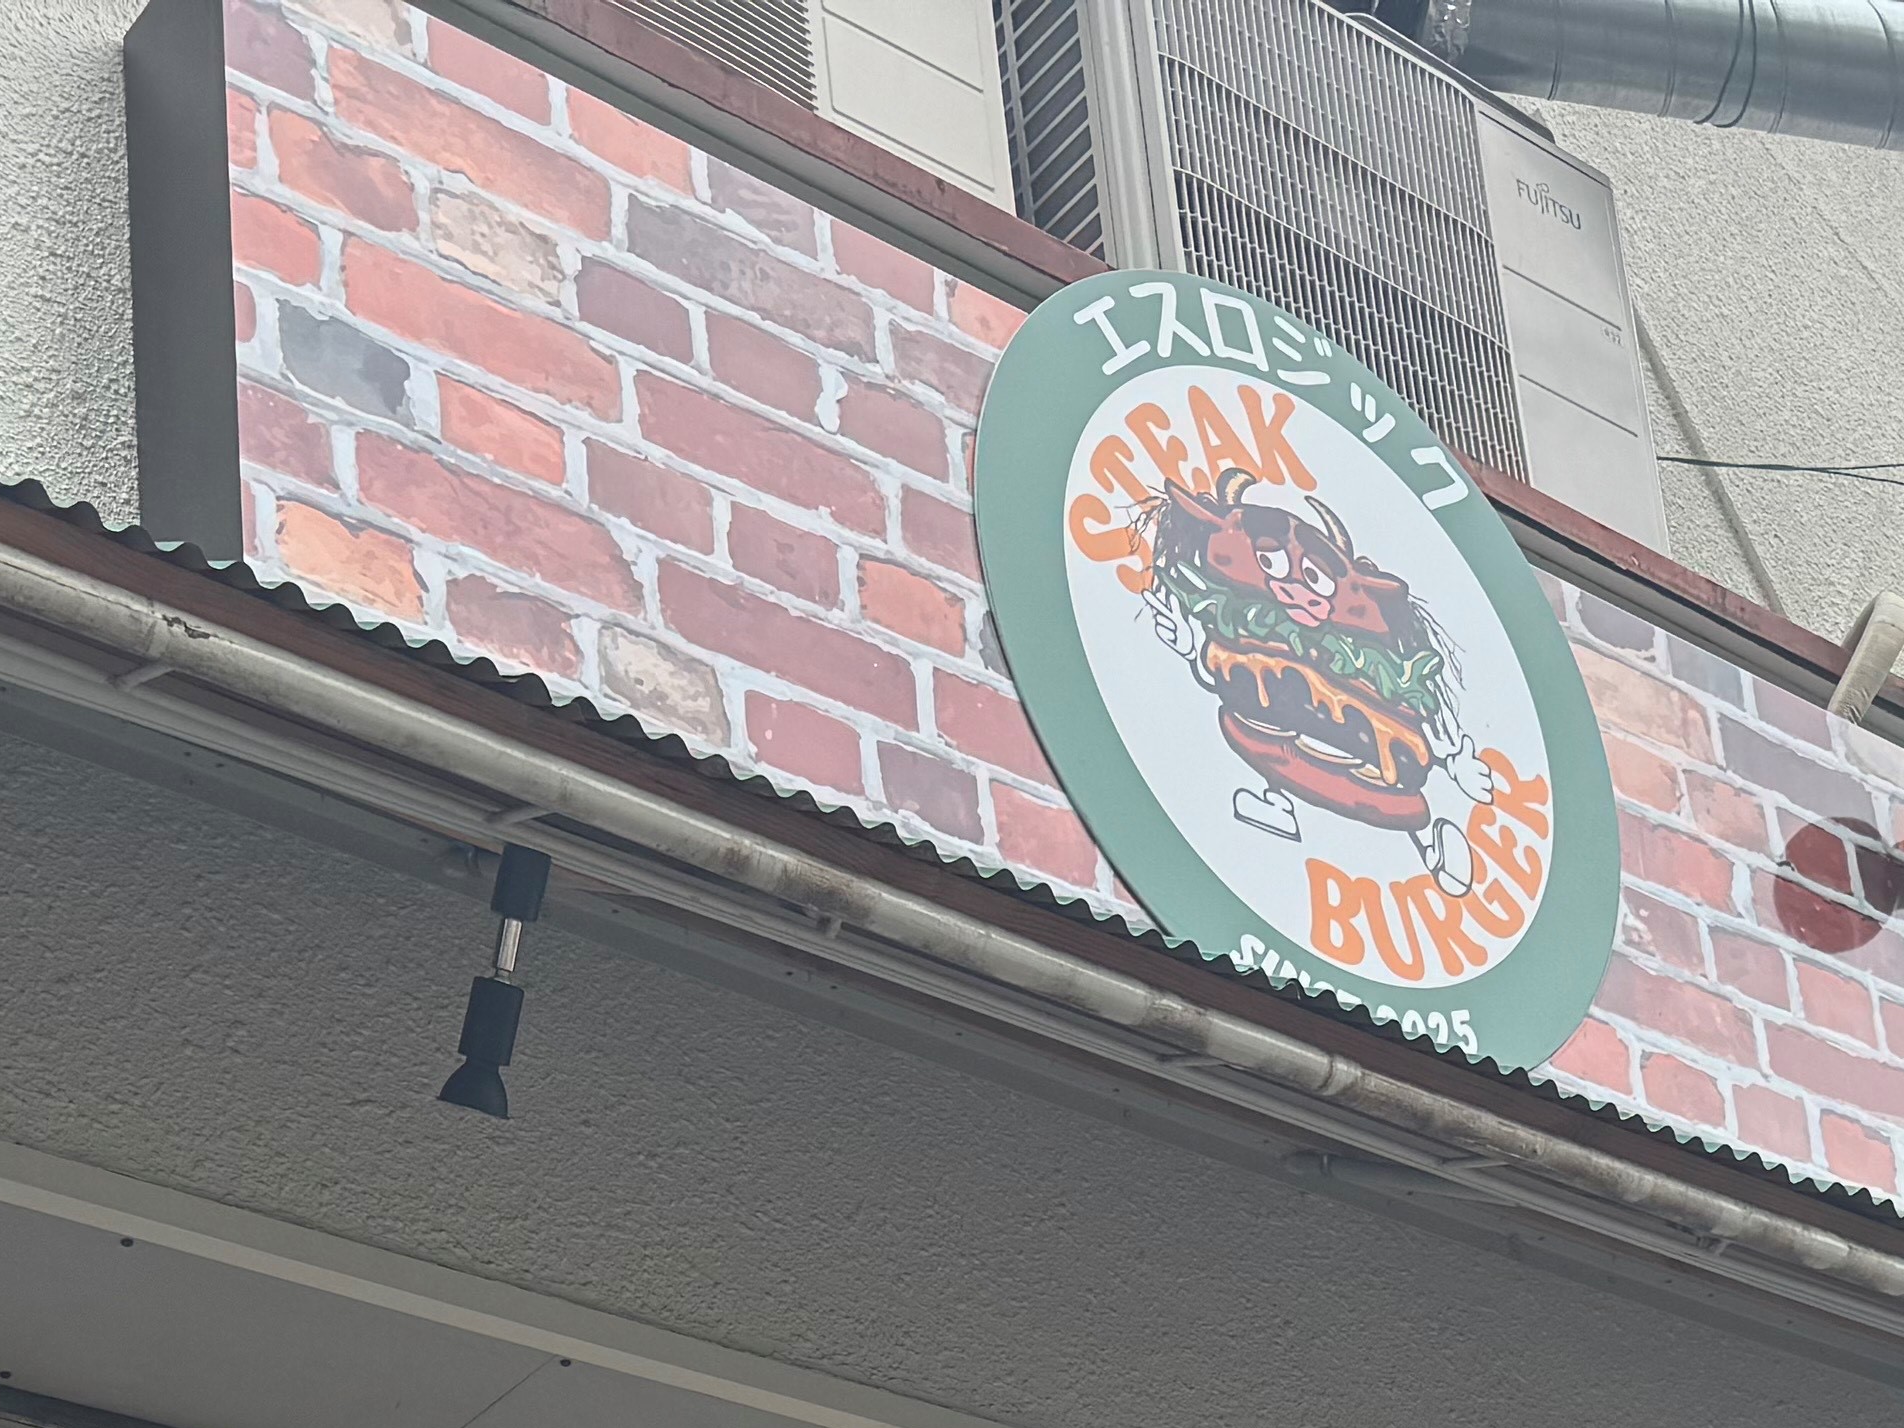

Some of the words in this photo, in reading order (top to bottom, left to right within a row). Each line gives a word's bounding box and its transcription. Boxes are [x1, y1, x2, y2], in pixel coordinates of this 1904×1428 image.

[1516, 179, 1582, 230] FUJITSU
[1068, 384, 1318, 594] STEAK
[1072, 281, 1470, 510] エスロジック
[1305, 747, 1554, 982] BURGER
